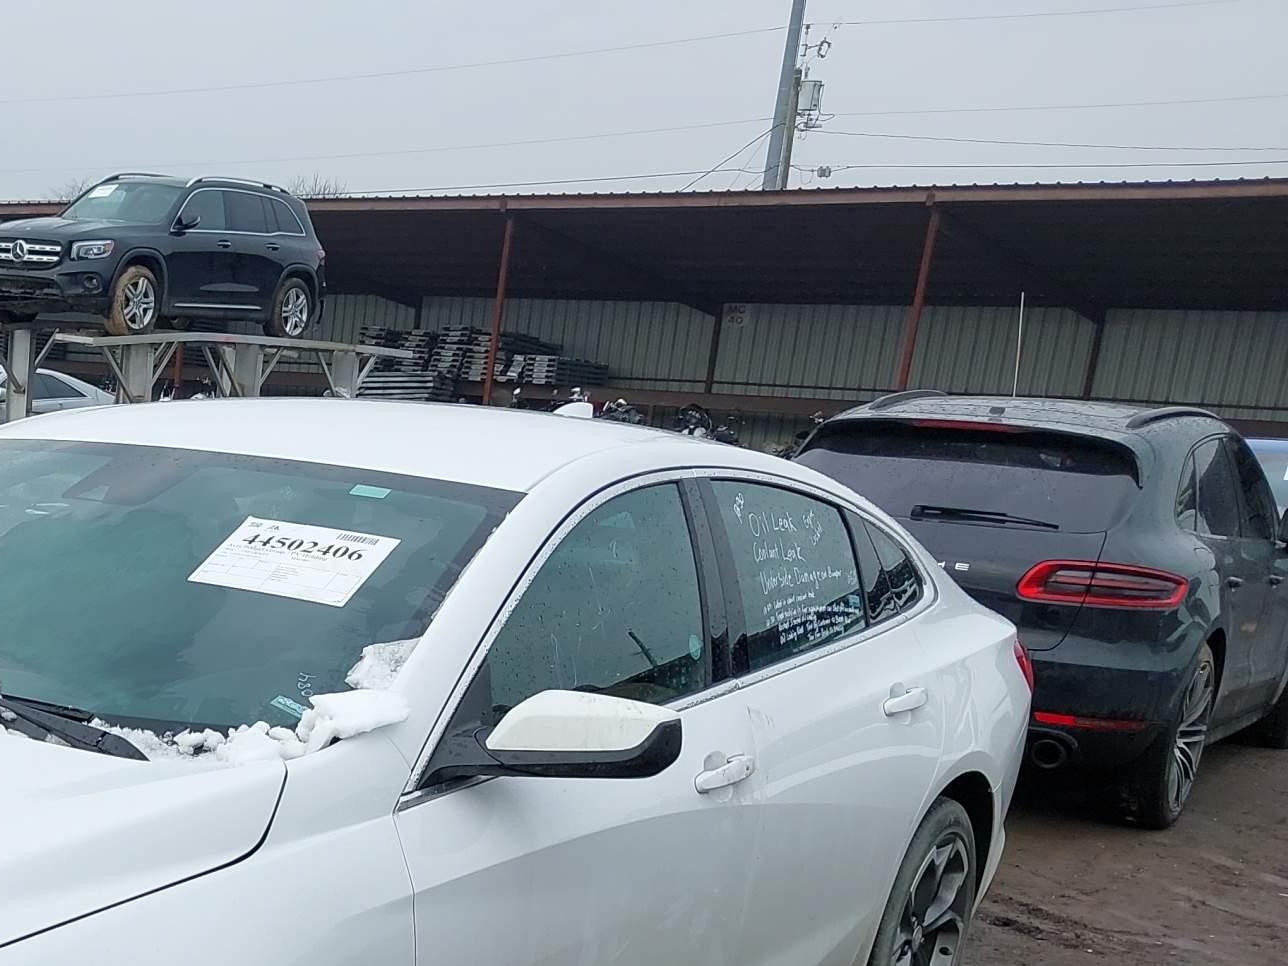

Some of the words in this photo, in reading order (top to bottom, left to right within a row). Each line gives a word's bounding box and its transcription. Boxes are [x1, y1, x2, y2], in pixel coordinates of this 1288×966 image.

[748, 511, 770, 537] Oil
[771, 511, 797, 533] Leak
[242, 533, 367, 561] 44502406
[779, 537, 806, 562] Leak
